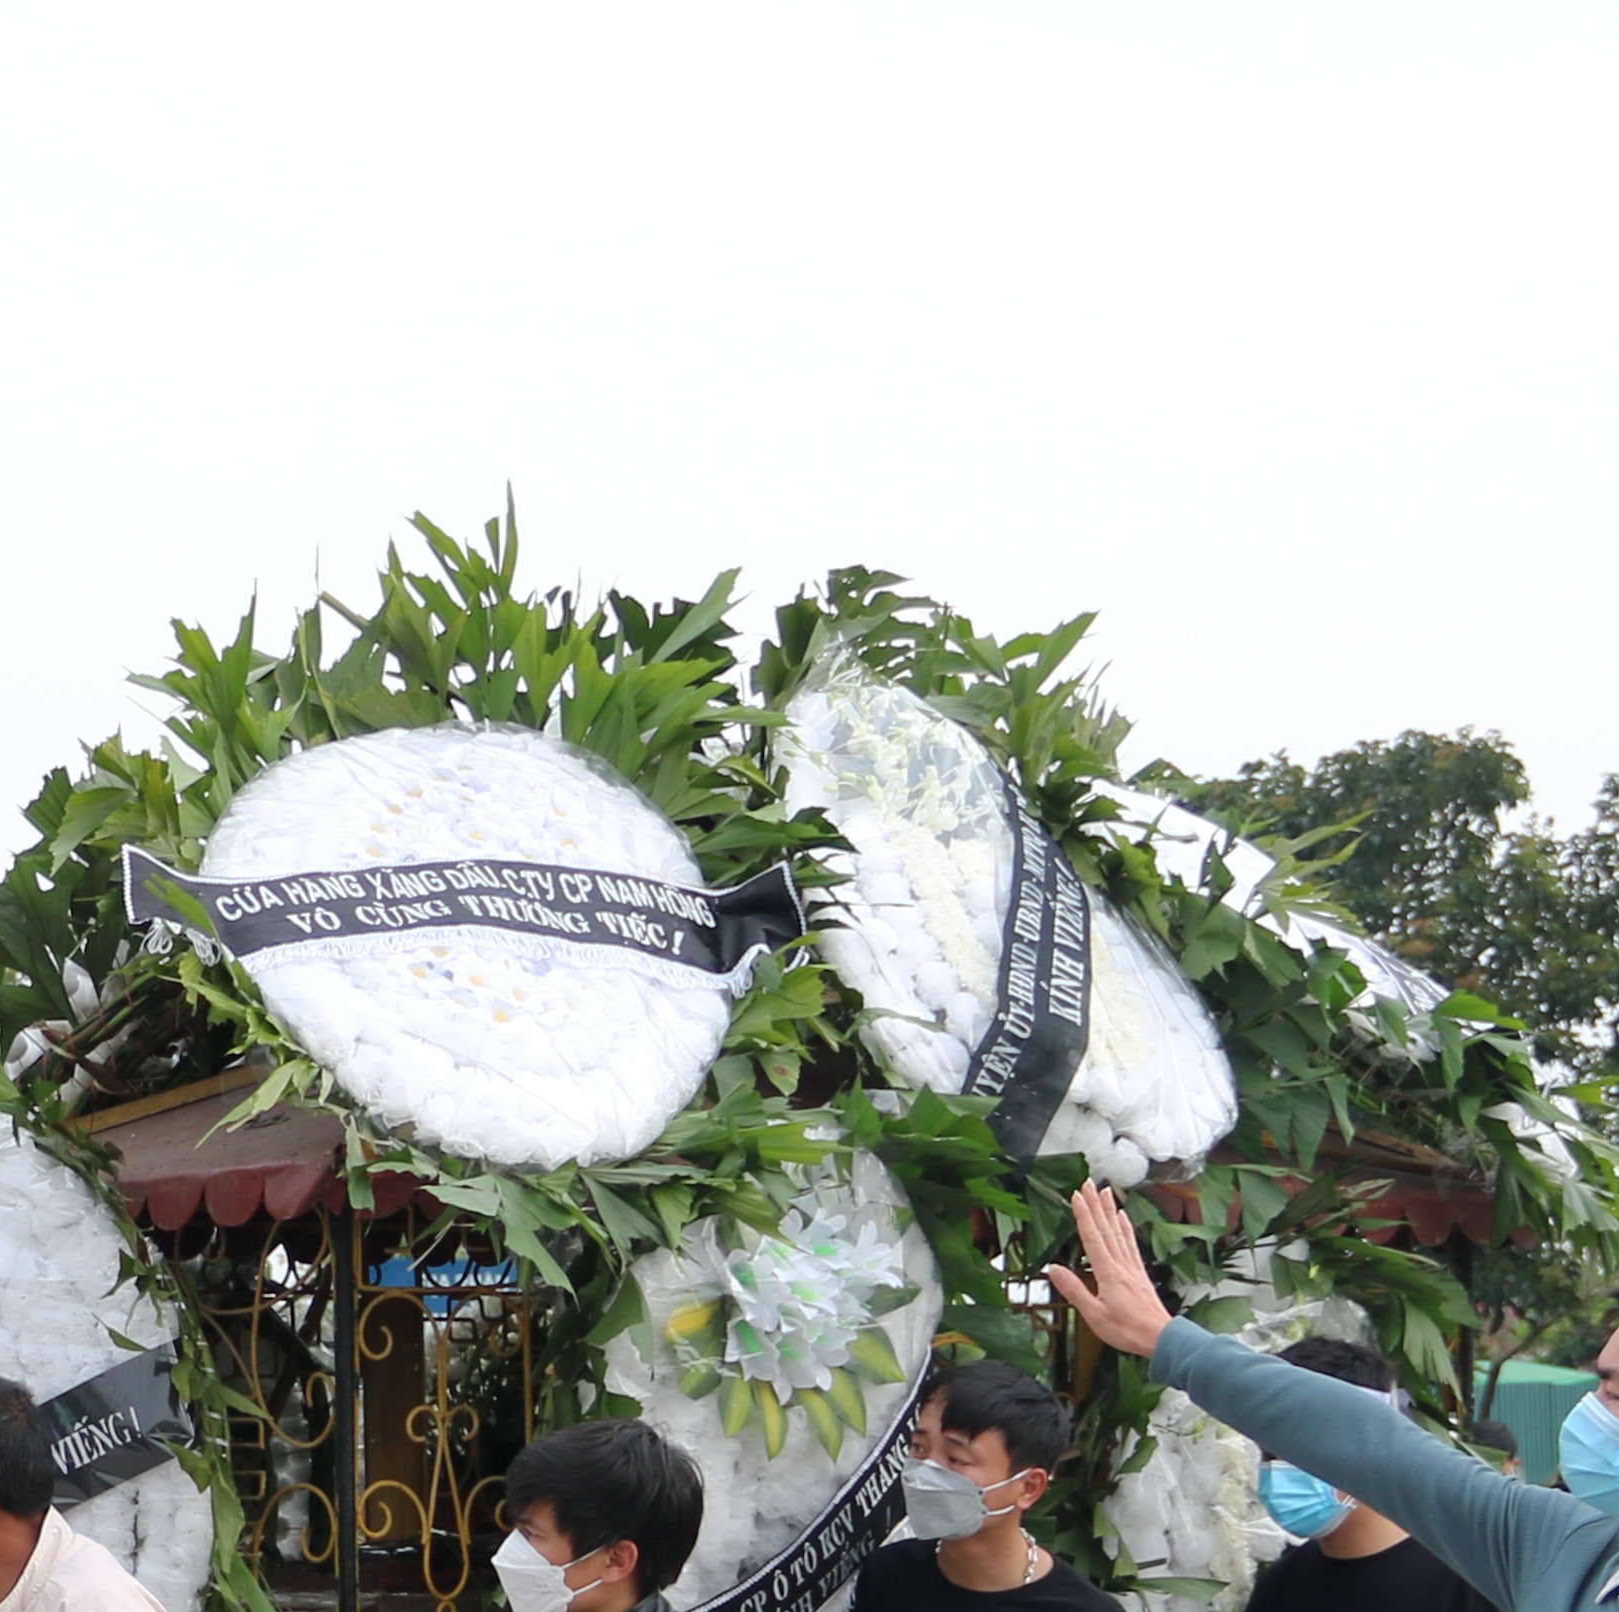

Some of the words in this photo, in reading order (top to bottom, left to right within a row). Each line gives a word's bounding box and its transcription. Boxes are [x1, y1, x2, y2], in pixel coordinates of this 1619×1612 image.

[216, 886, 283, 922] CỬA
[280, 873, 366, 906] HÀNG
[364, 867, 448, 900] XĂNG
[558, 872, 593, 904] CP
[595, 874, 656, 909] NAM
[649, 884, 717, 928] HỒNG
[286, 907, 342, 934] VÔ
[355, 900, 452, 927] CÙNG
[458, 895, 591, 934] THƯƠNG
[1039, 948, 1084, 1027] KÍNH
[51, 1406, 142, 1475] VIẾNG!
[773, 1569, 789, 1601] Ô
[790, 1542, 817, 1586] TÔ
